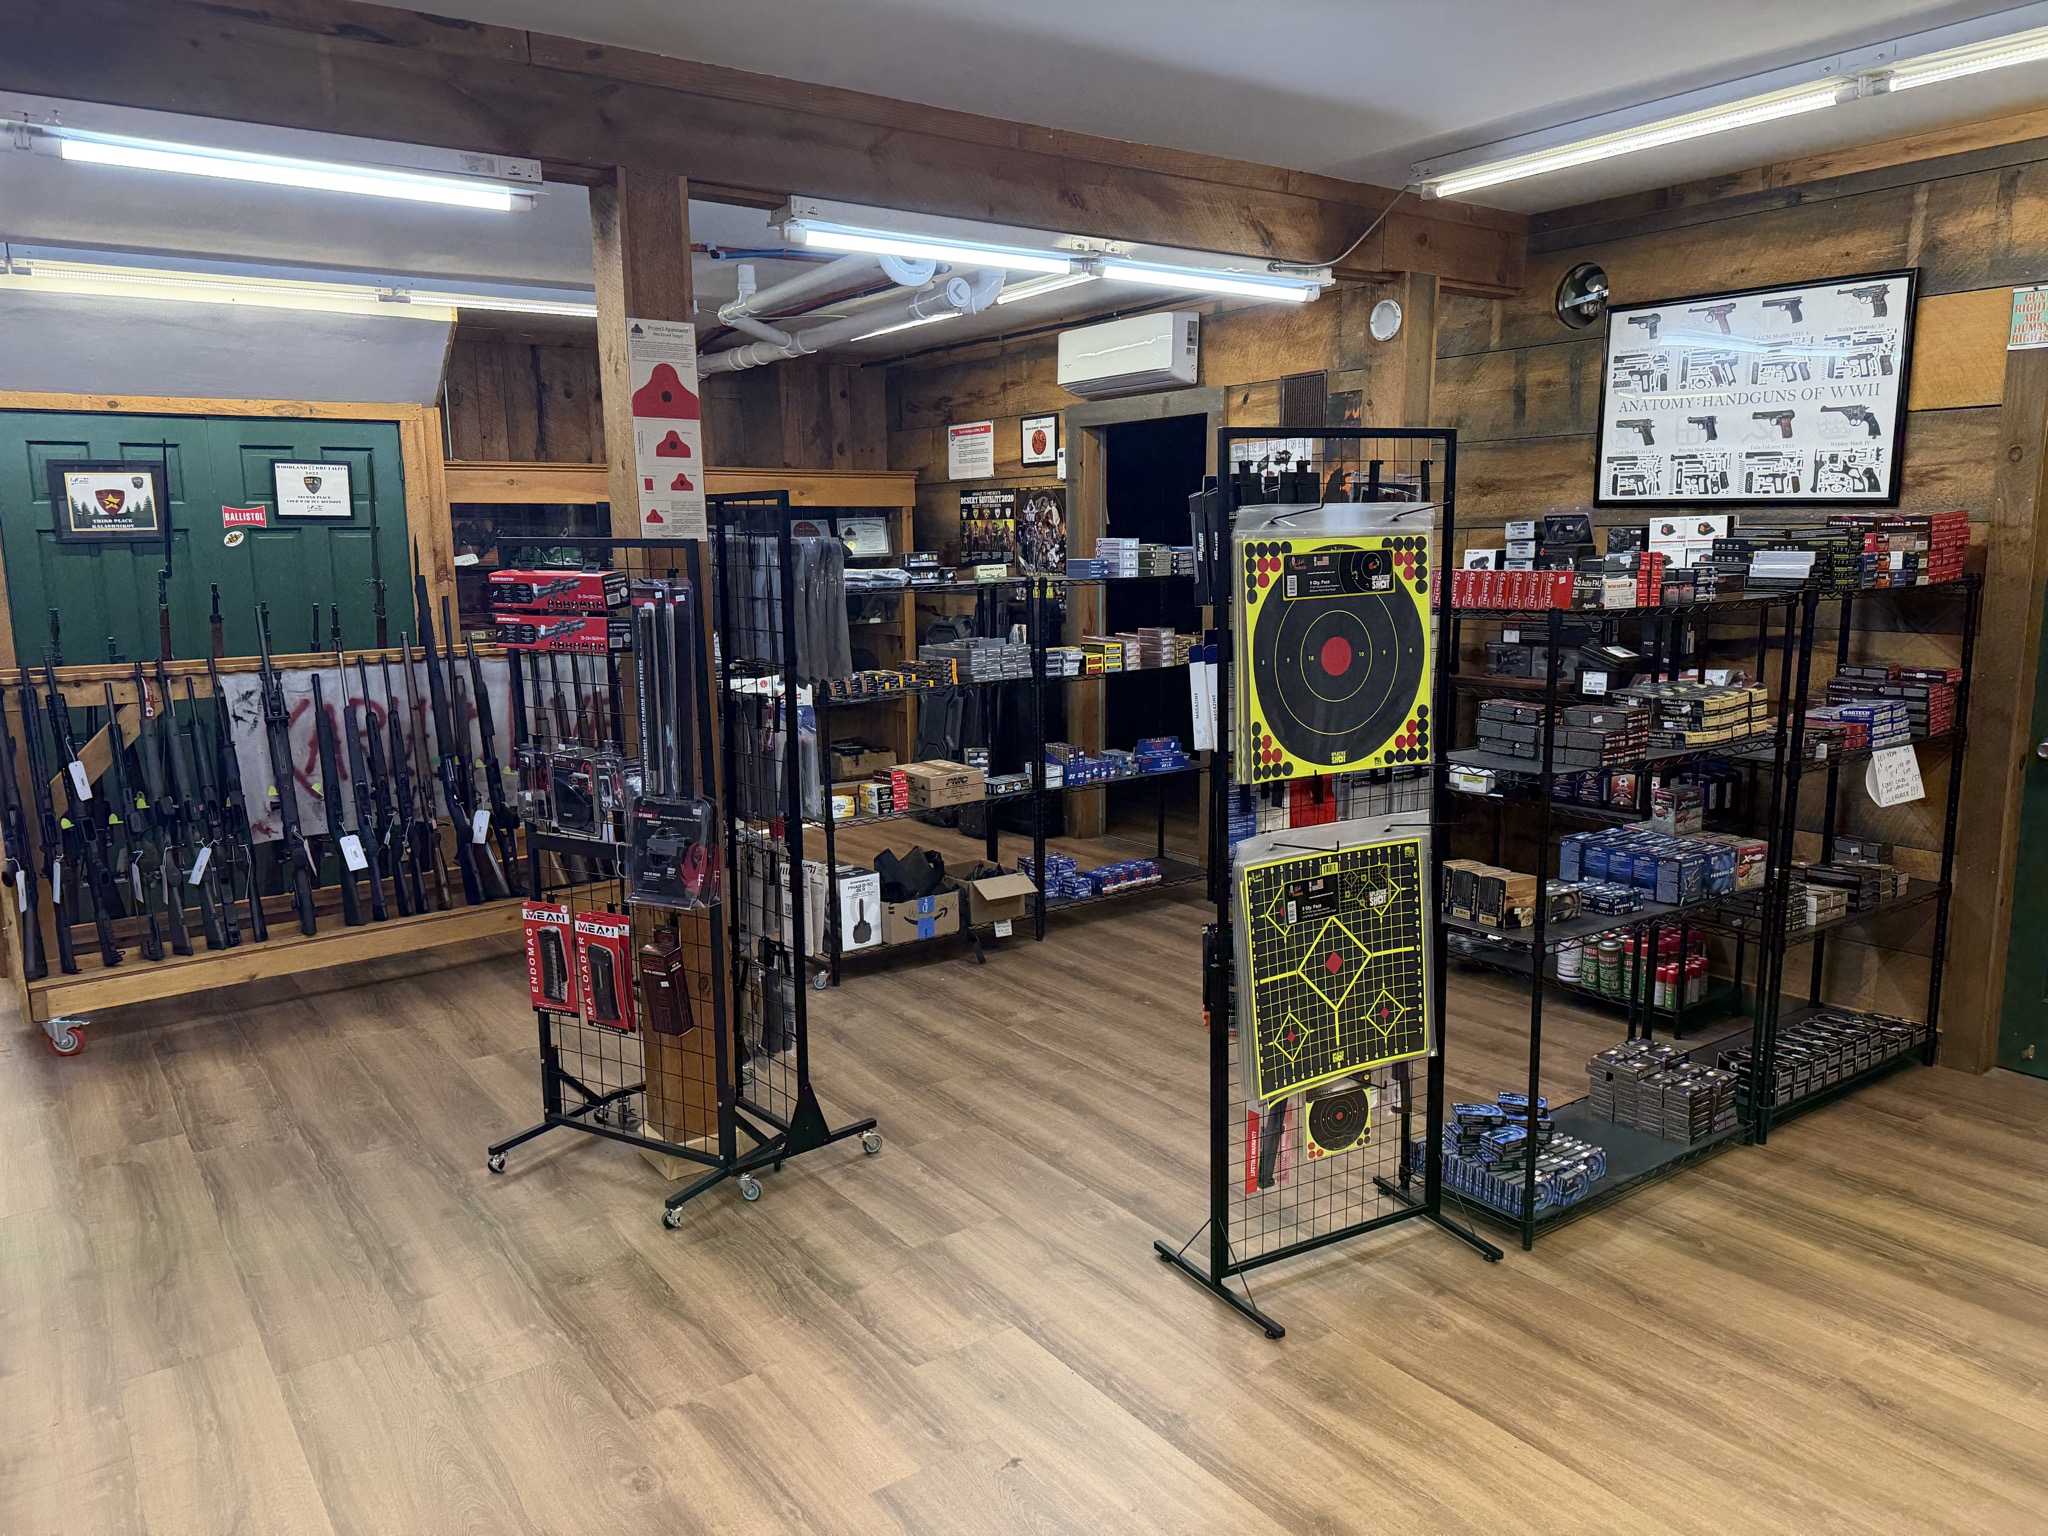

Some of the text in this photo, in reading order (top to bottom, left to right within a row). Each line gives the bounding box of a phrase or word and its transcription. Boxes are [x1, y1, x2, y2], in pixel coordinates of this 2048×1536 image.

[2026, 293, 2047, 302] GUN
[2025, 313, 2042, 322] ARE
[1801, 387, 1825, 400] OF
[1830, 383, 1881, 398] WWII
[225, 512, 264, 521] BALLISTOL
[1372, 580, 1390, 589] SHOT
[1574, 577, 1581, 586] 45
[946, 776, 968, 786] PMC
[1679, 800, 1700, 809] XPERT
[1369, 895, 1386, 906] SHOT
[525, 910, 566, 923] MEAN
[578, 923, 614, 937] MEAN
[525, 927, 538, 993] ENDOMAG
[578, 936, 594, 1016] MA LOADER
